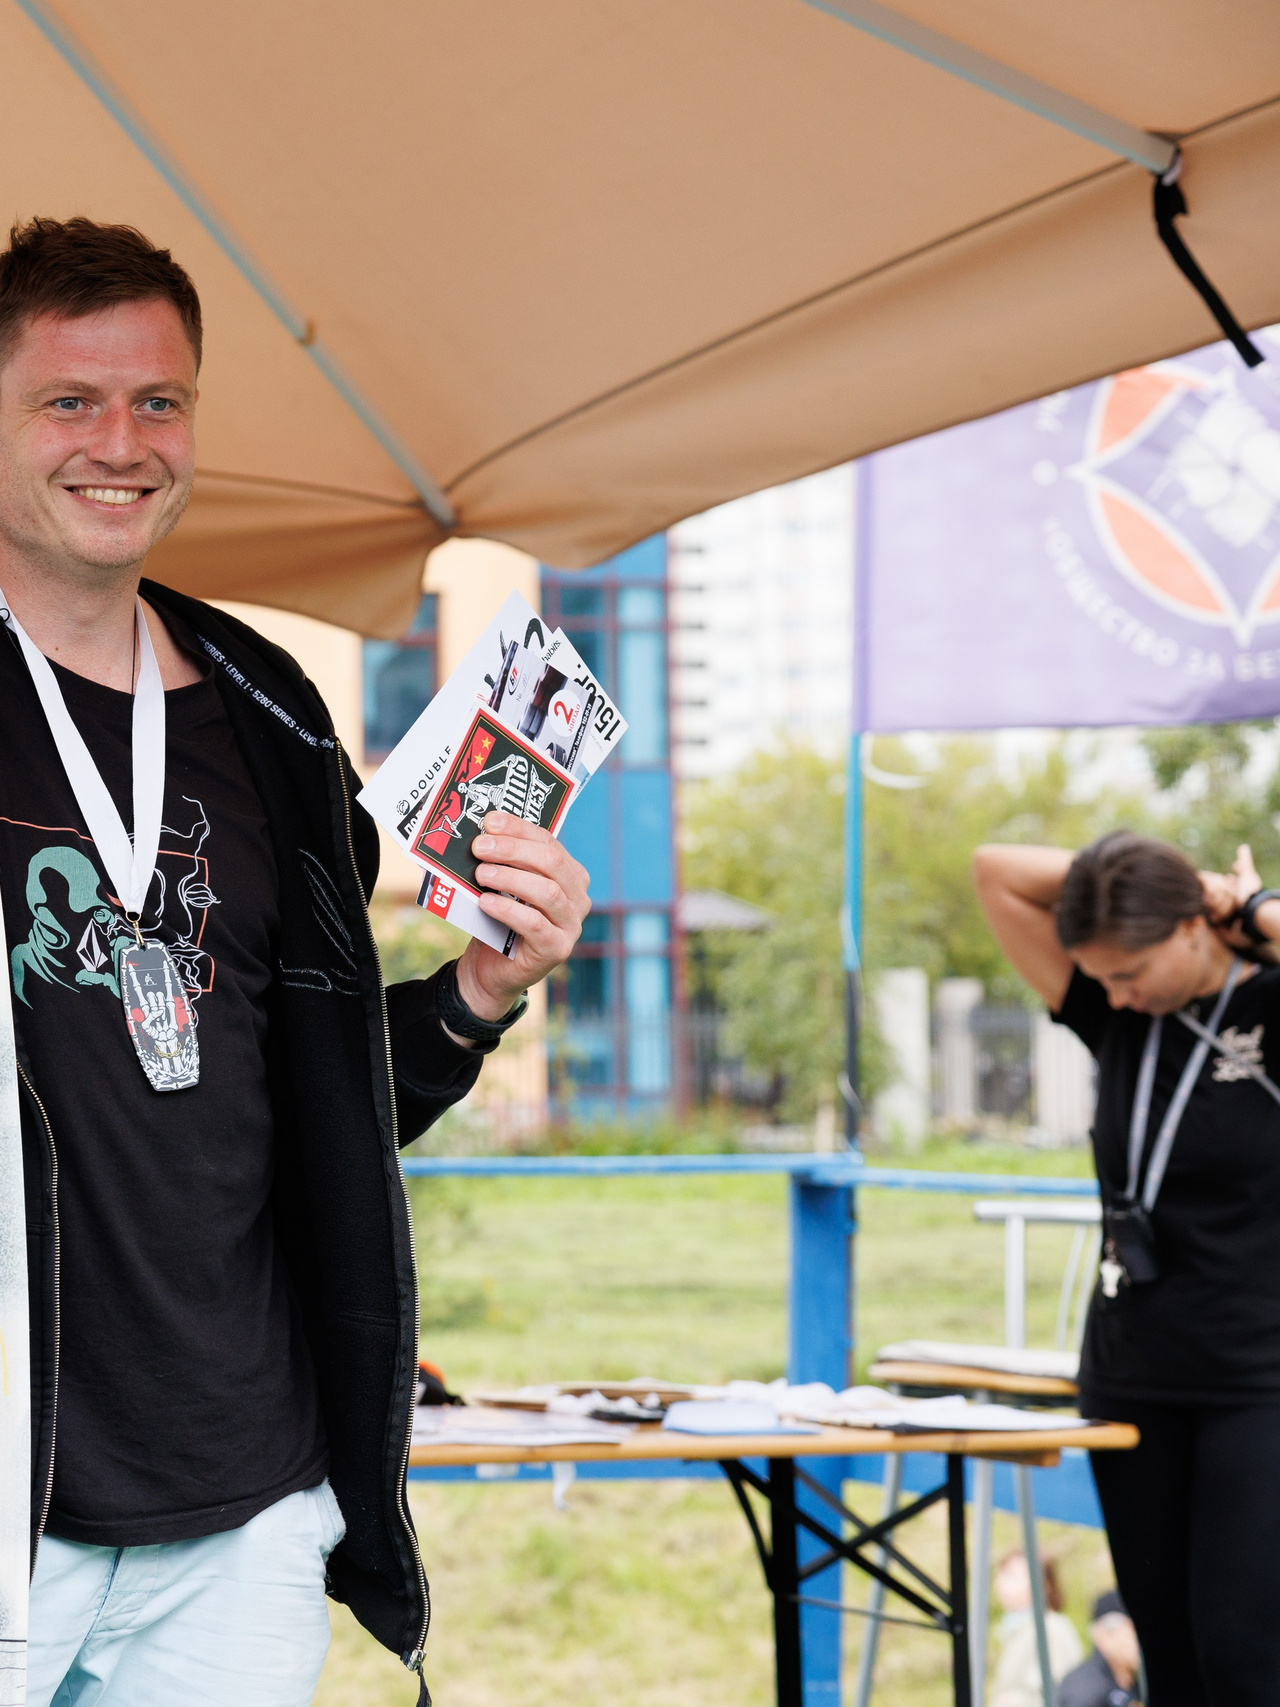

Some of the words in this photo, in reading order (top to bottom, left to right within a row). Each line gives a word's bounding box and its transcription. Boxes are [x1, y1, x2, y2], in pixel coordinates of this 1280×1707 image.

[225, 663, 246, 687] LEVEL
[253, 689, 271, 709] 5280
[270, 704, 298, 729] SERIES
[299, 728, 318, 747] LEVEL
[554, 700, 574, 725] 2
[433, 880, 453, 908] СЕ
